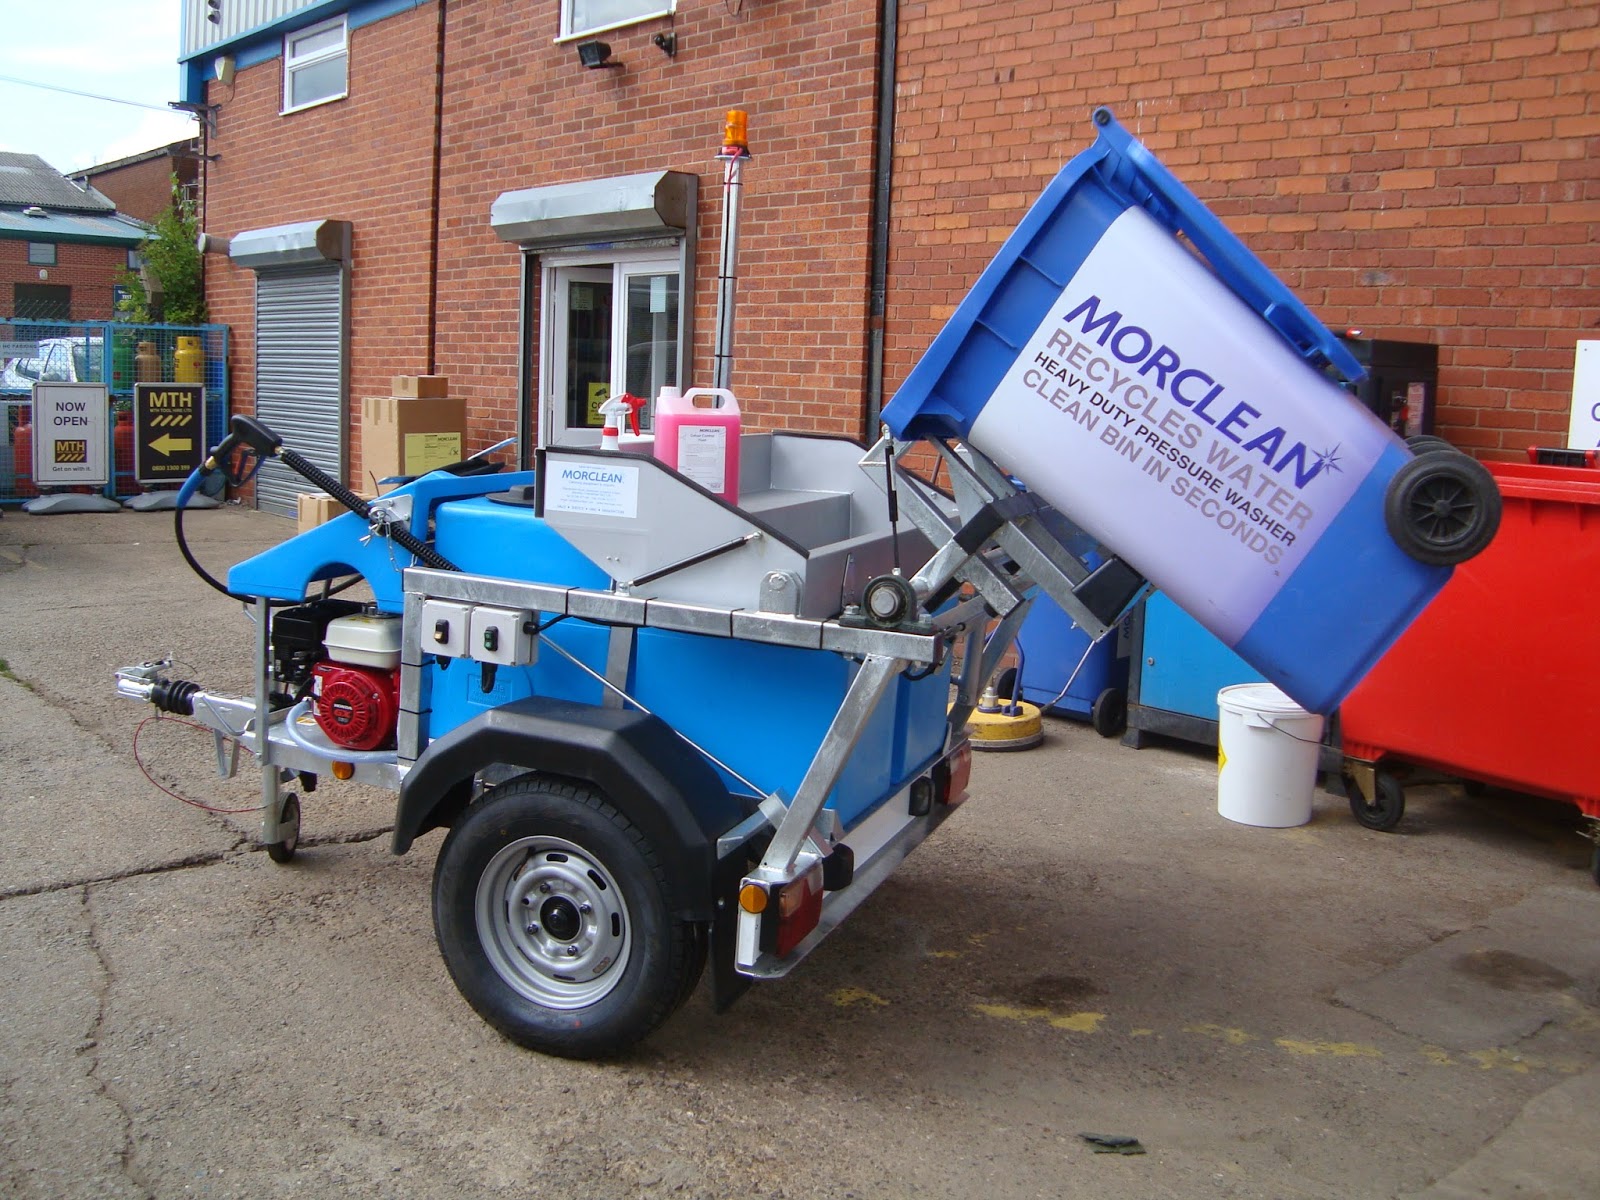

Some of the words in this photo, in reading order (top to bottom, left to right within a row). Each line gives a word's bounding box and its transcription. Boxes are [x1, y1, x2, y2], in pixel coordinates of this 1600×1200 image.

[150, 392, 192, 407] MTH
[1063, 295, 1324, 490] MORCLEAN
[55, 402, 86, 411] NOW
[53, 416, 88, 426] OPEN
[1046, 328, 1203, 450] RECYCLES
[1206, 440, 1314, 530] WATER
[57, 441, 85, 451] MTH
[1034, 352, 1090, 395] HEAVY
[1090, 390, 1136, 428] DUTY
[1135, 424, 1223, 494] PRESSURE
[1225, 488, 1297, 547] WASHER
[1023, 369, 1101, 433] CLEAN
[1100, 427, 1144, 463] BIN
[1142, 455, 1171, 483] IN
[1171, 477, 1285, 566] SECONDS
[562, 469, 623, 484] MORCLEAN
